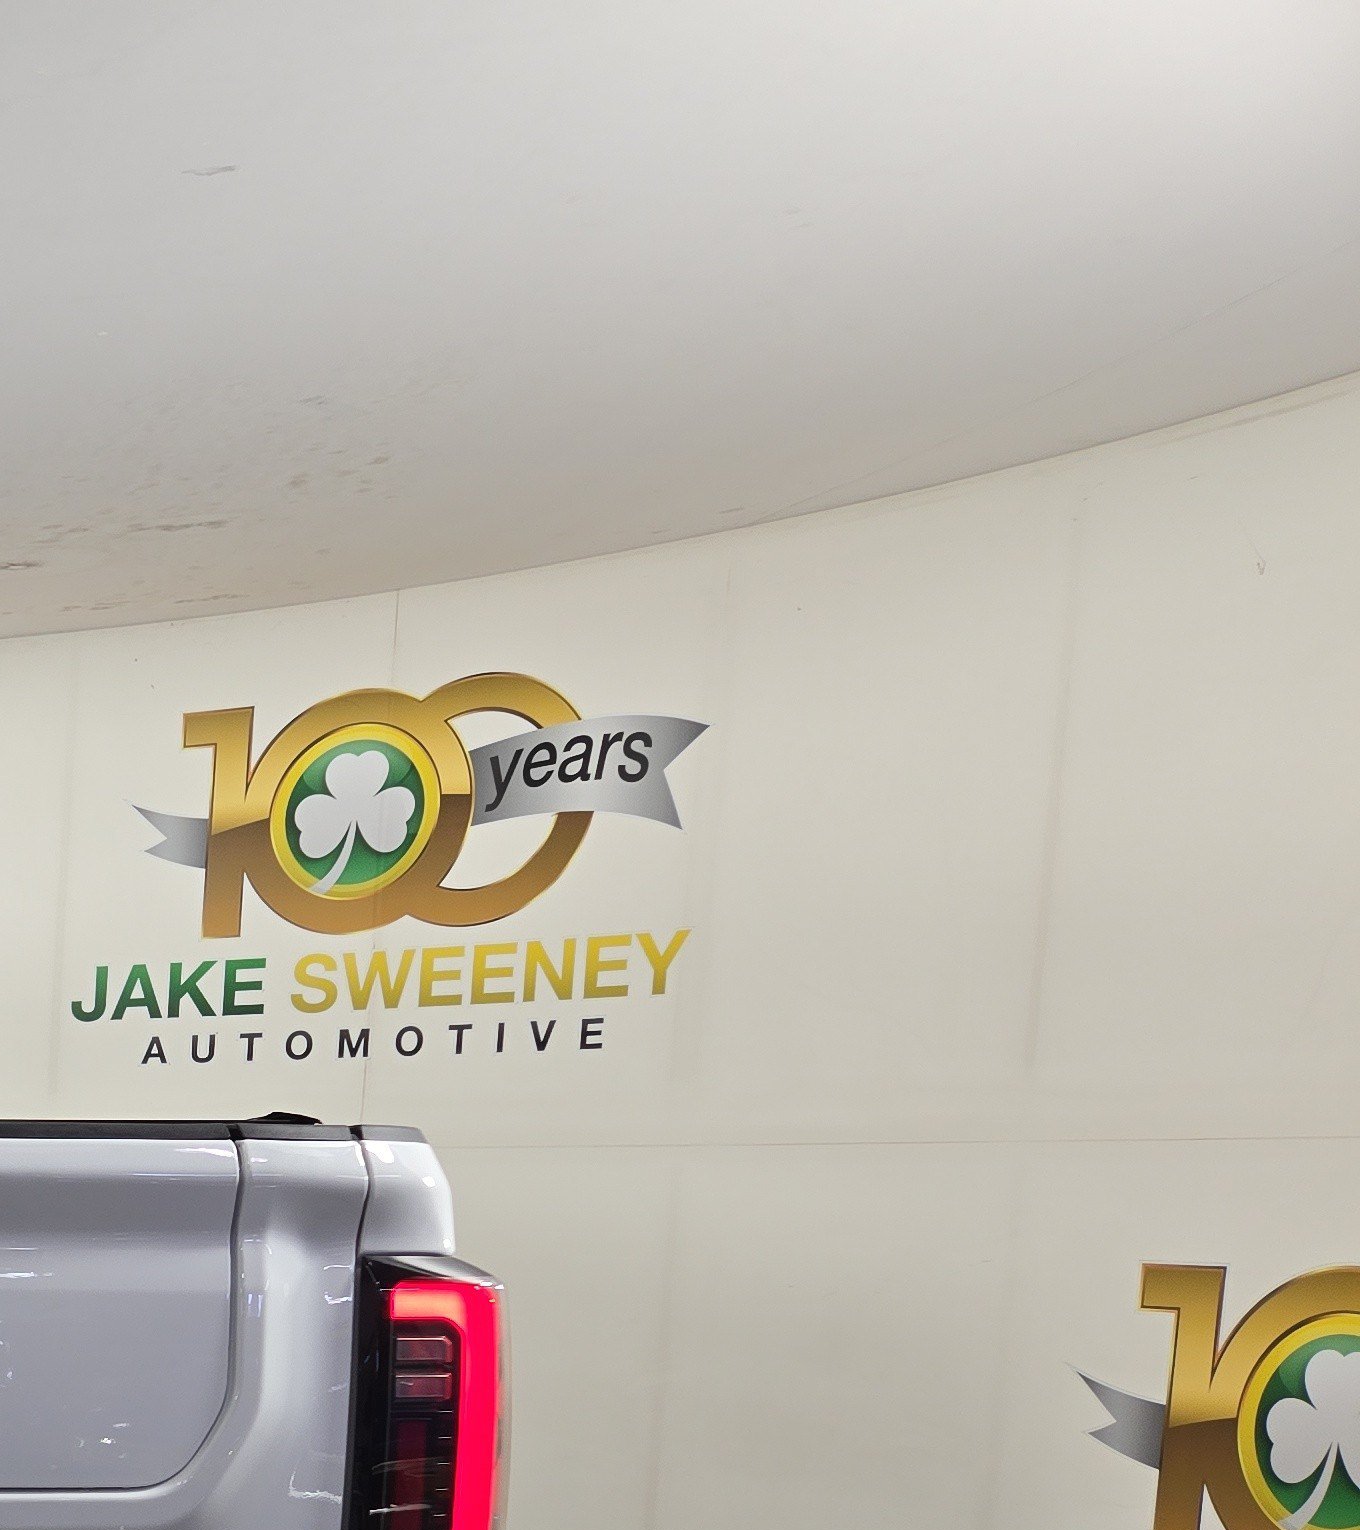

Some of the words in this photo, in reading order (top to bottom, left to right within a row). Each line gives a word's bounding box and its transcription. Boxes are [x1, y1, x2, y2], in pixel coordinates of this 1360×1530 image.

[183, 672, 596, 939] 100
[485, 728, 653, 813] years
[71, 957, 268, 1023] JAKE
[290, 929, 691, 1014] SWEENEY
[141, 1017, 605, 1065] AUTOMOTIVE
